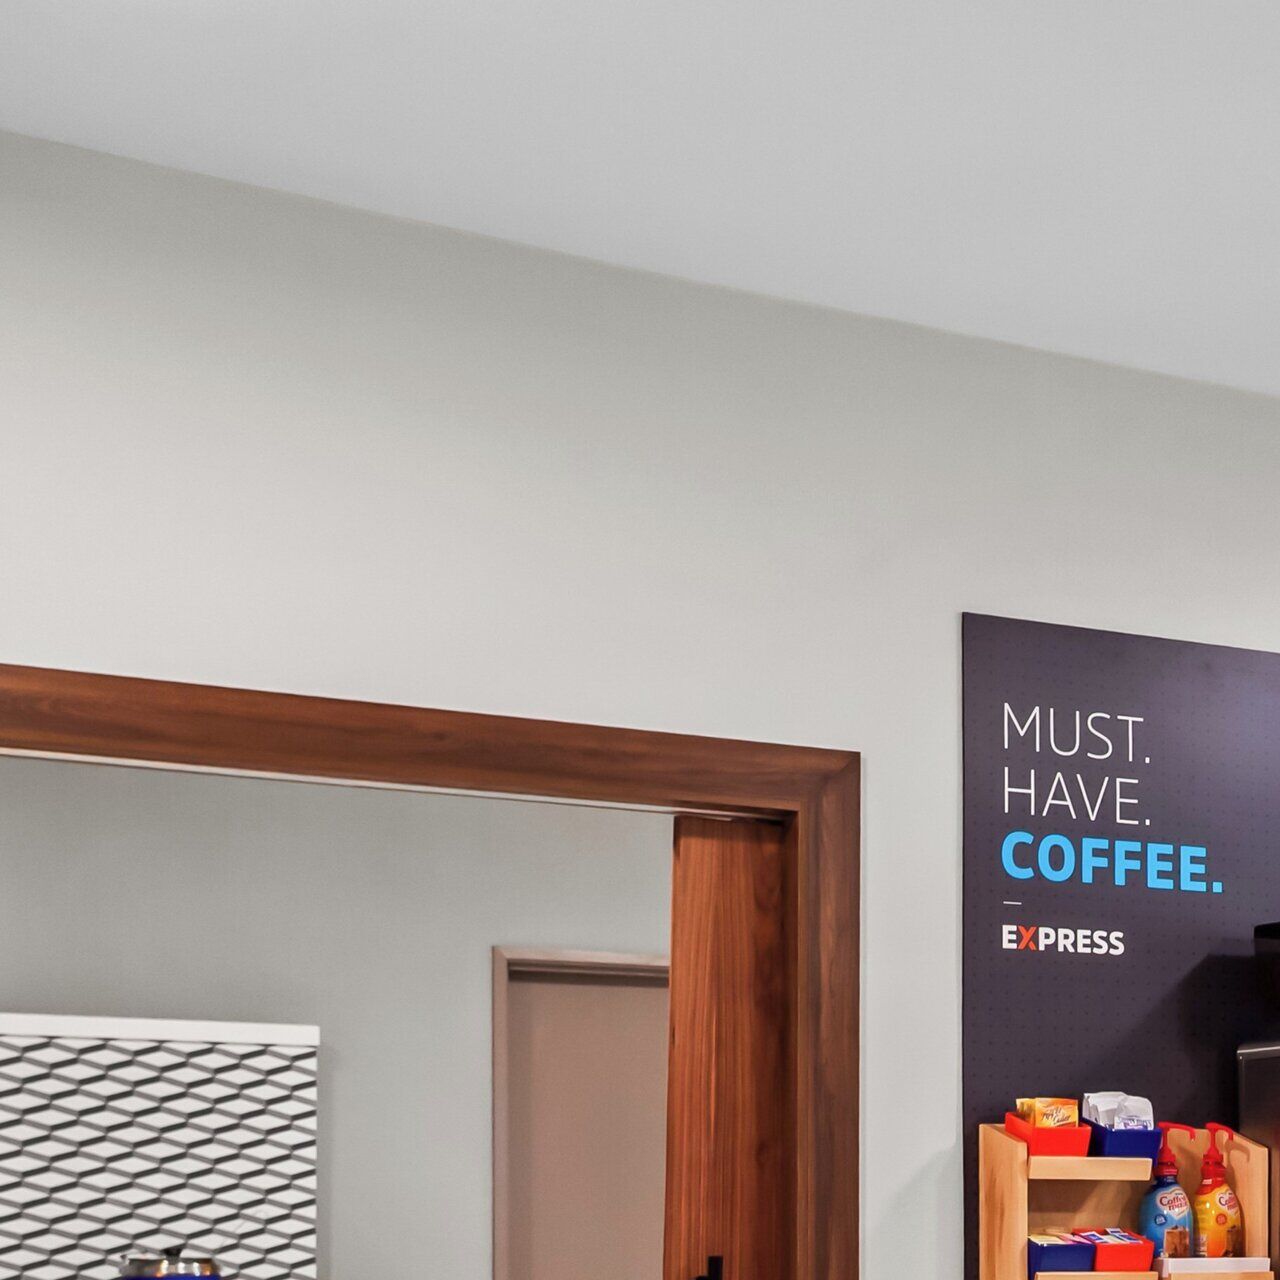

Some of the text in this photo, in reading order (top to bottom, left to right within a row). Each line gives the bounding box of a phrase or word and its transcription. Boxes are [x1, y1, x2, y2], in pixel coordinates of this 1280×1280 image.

[1003, 702, 1150, 763] MUST.
[1003, 766, 1150, 826] HAVE.
[1001, 831, 1223, 893] COFFEE.
[1002, 924, 1125, 956] EXPRESS
